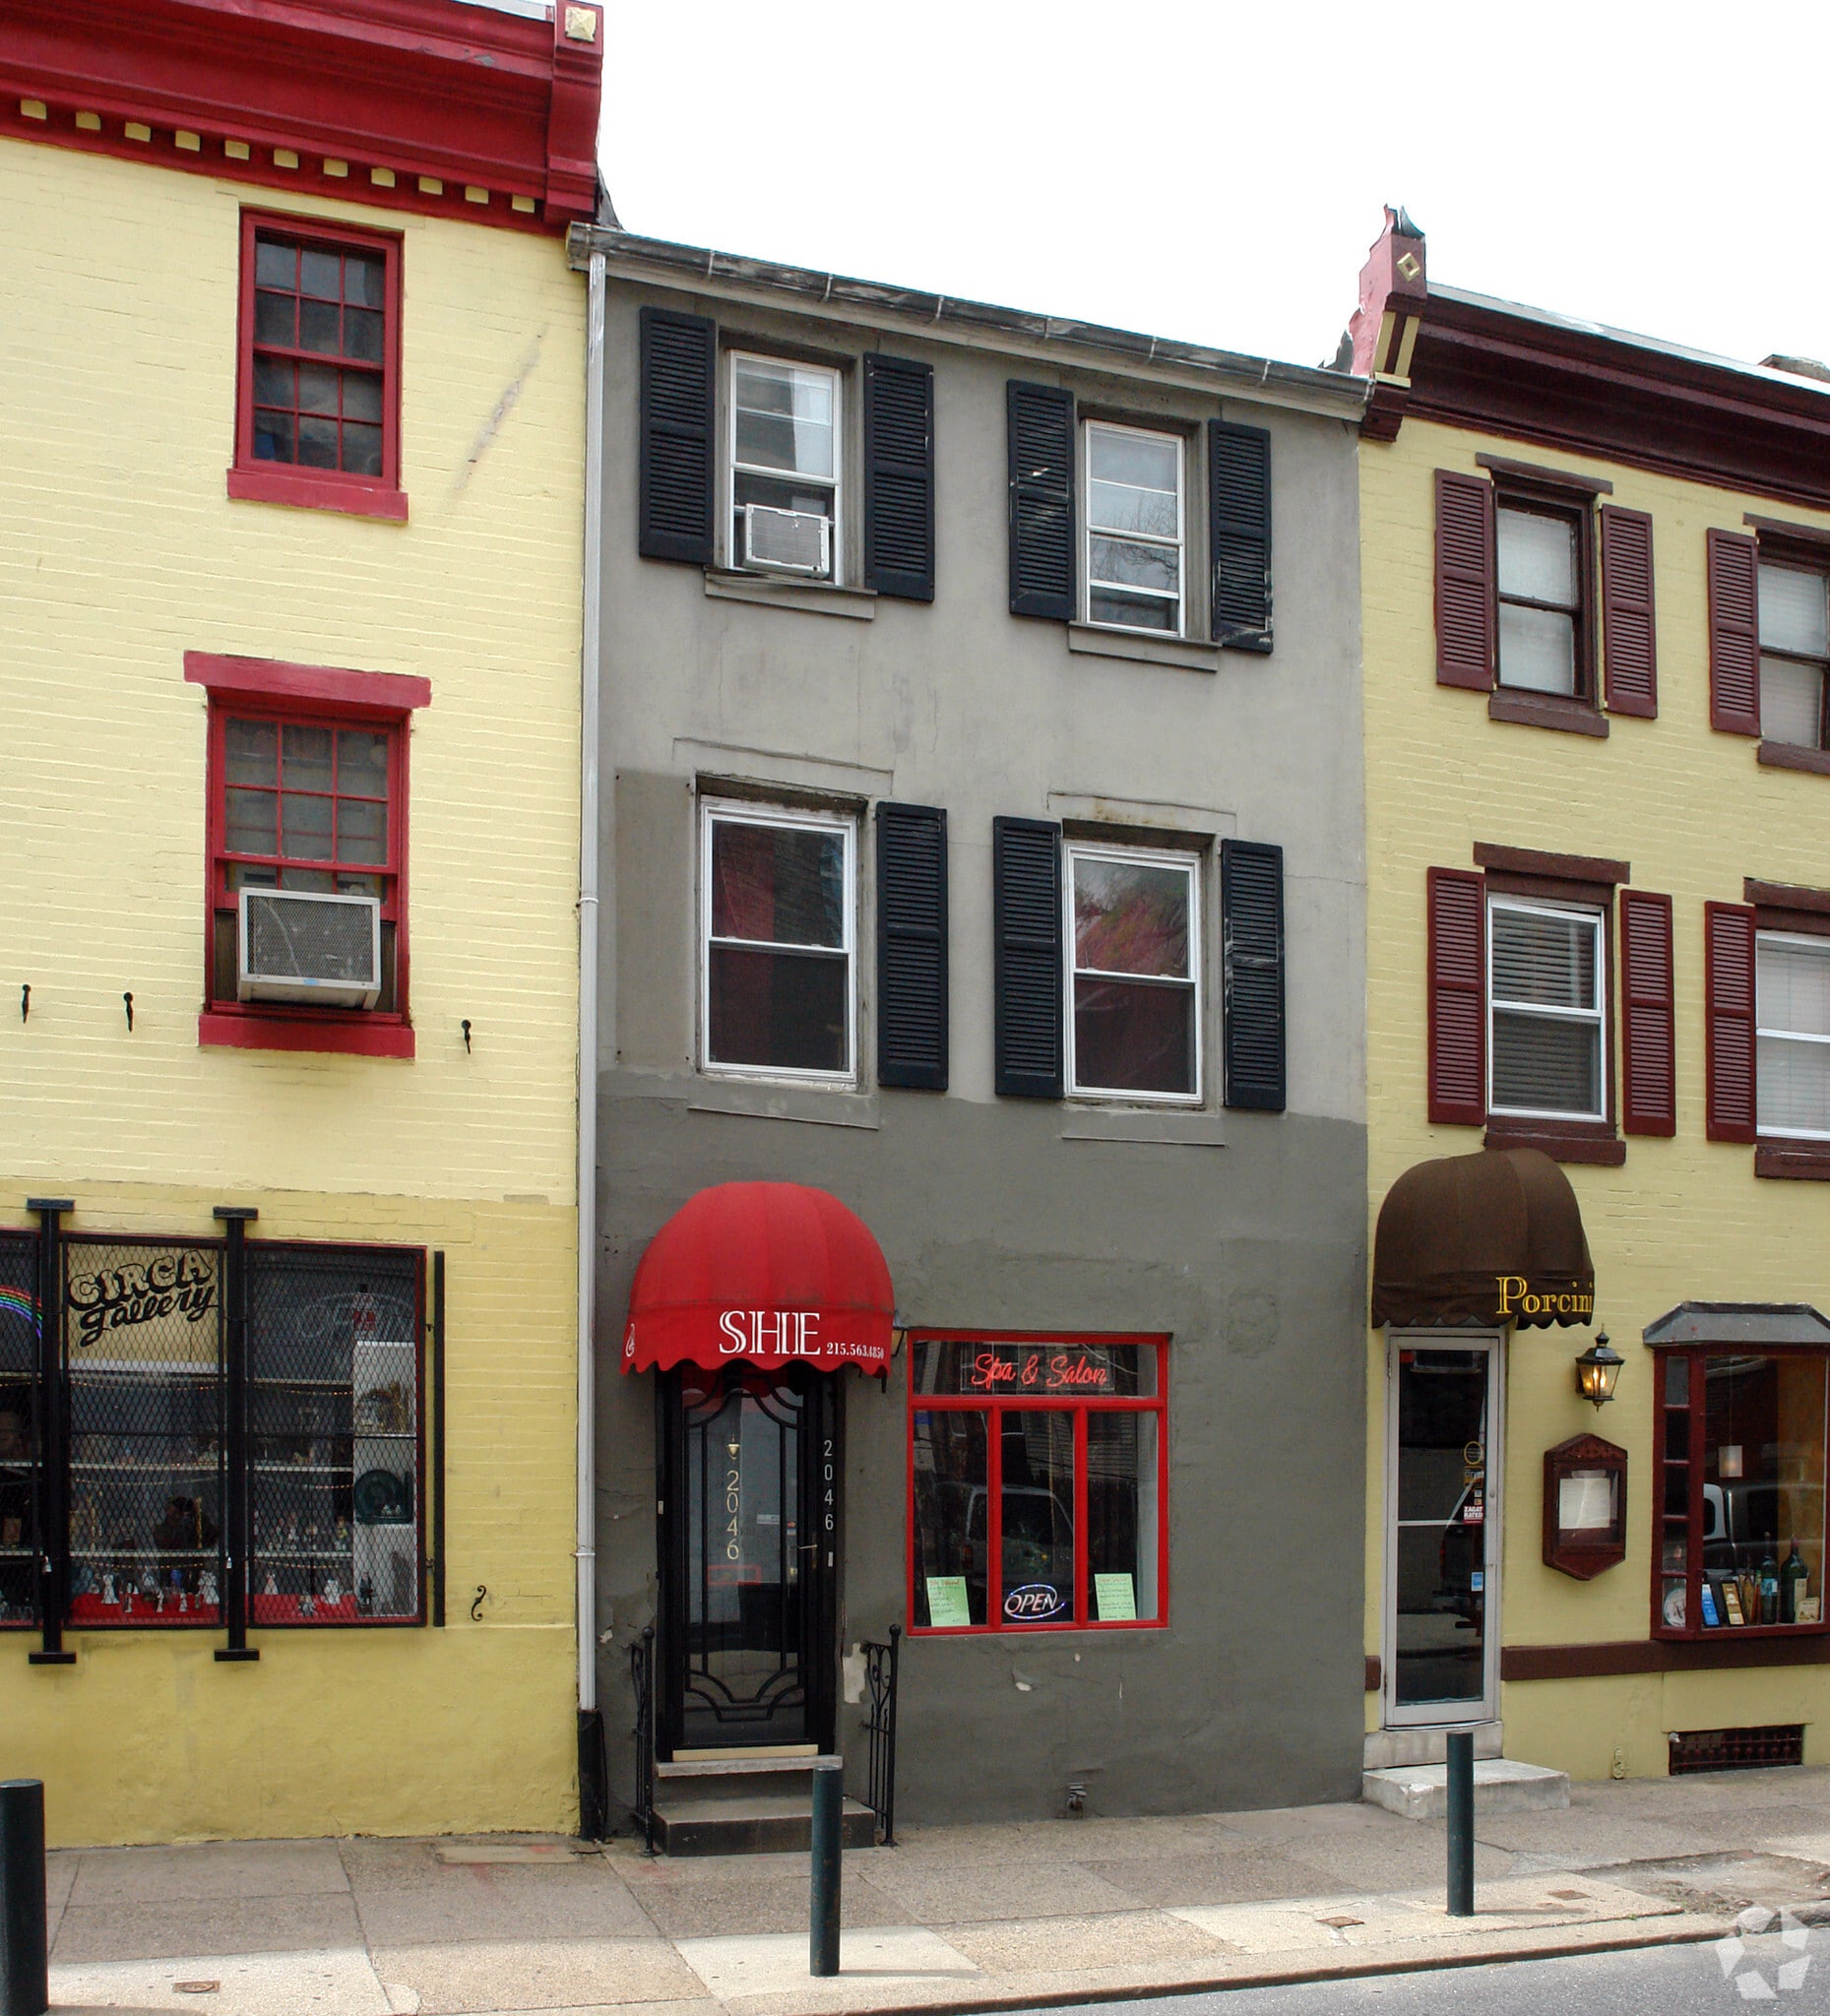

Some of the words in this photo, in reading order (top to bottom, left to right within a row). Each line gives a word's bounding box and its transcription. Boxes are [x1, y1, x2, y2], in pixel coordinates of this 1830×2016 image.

[69, 1250, 213, 1311] CIRCA
[719, 1310, 821, 1355] SHE
[971, 1354, 1017, 1389] Spa
[1021, 1354, 1039, 1385] &
[1045, 1354, 1107, 1388] Salon
[824, 1439, 834, 1531] 2046
[726, 1470, 739, 1560] 2046
[1004, 1594, 1054, 1613] OPEN
